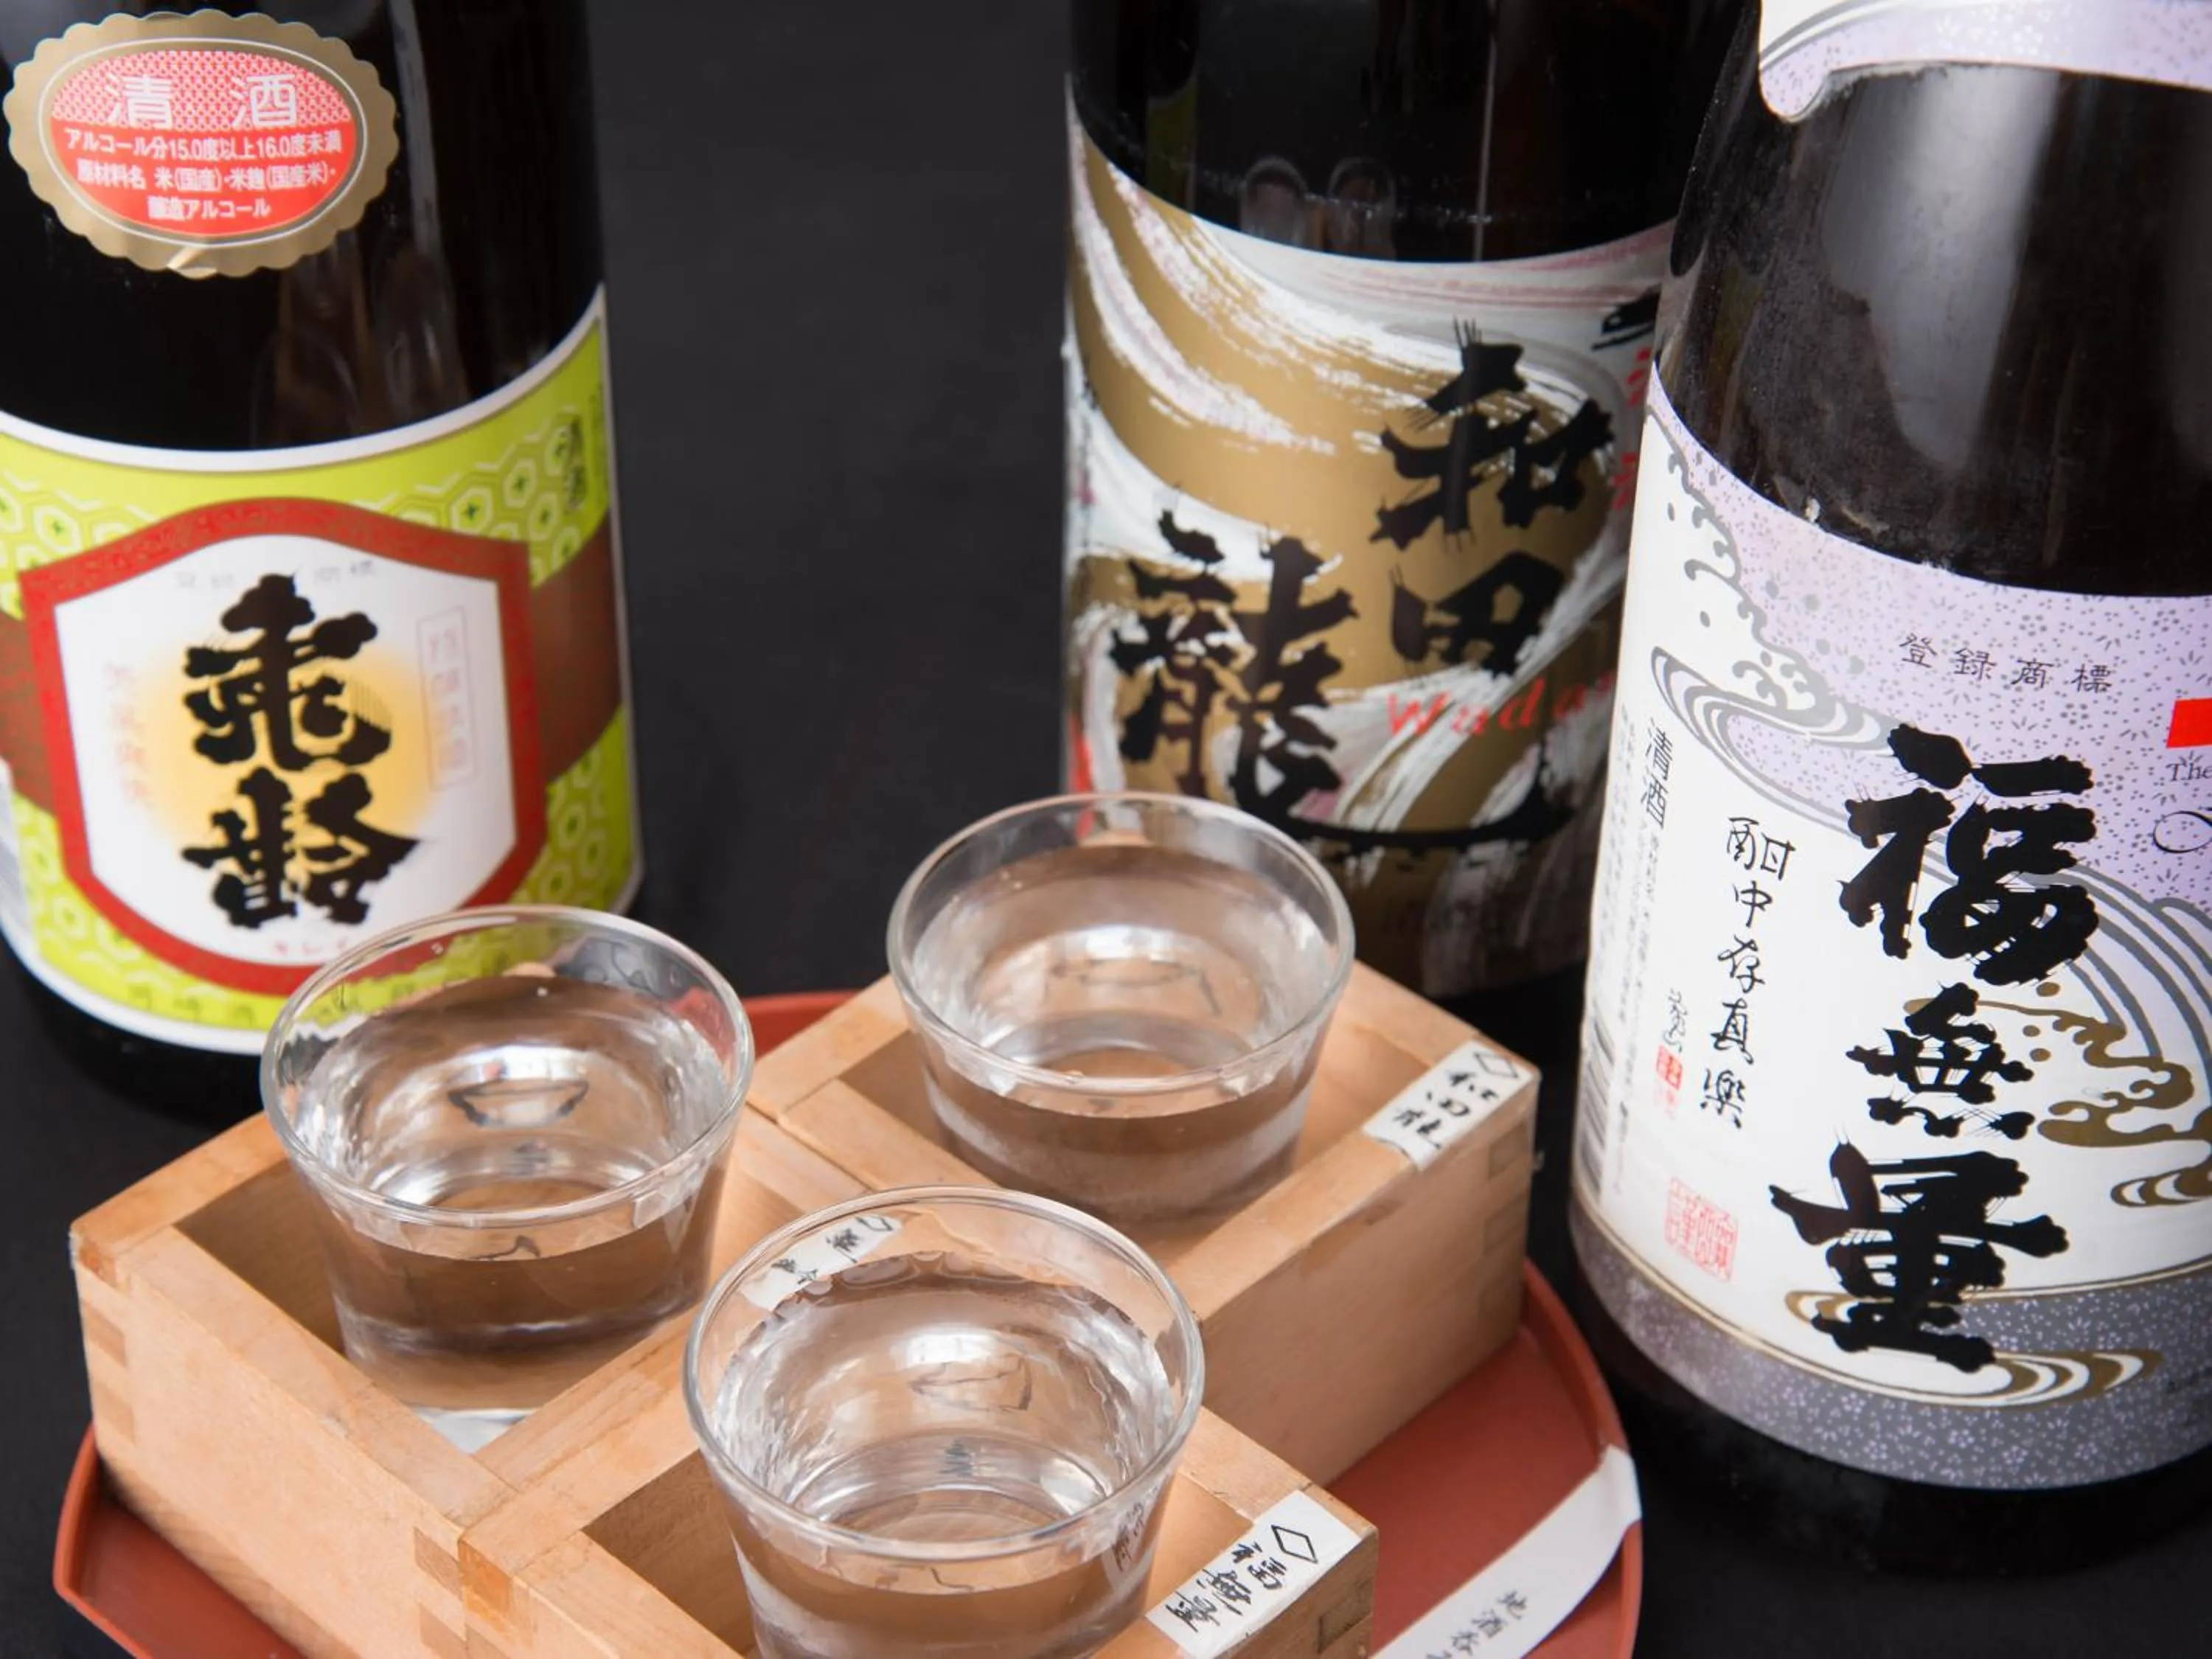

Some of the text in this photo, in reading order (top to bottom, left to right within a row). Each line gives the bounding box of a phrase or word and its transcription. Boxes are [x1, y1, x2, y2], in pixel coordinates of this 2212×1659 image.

[105, 73, 297, 130] 清酒
[1899, 632, 2112, 694] 登録商標
[1640, 717, 1674, 830] 清酒
